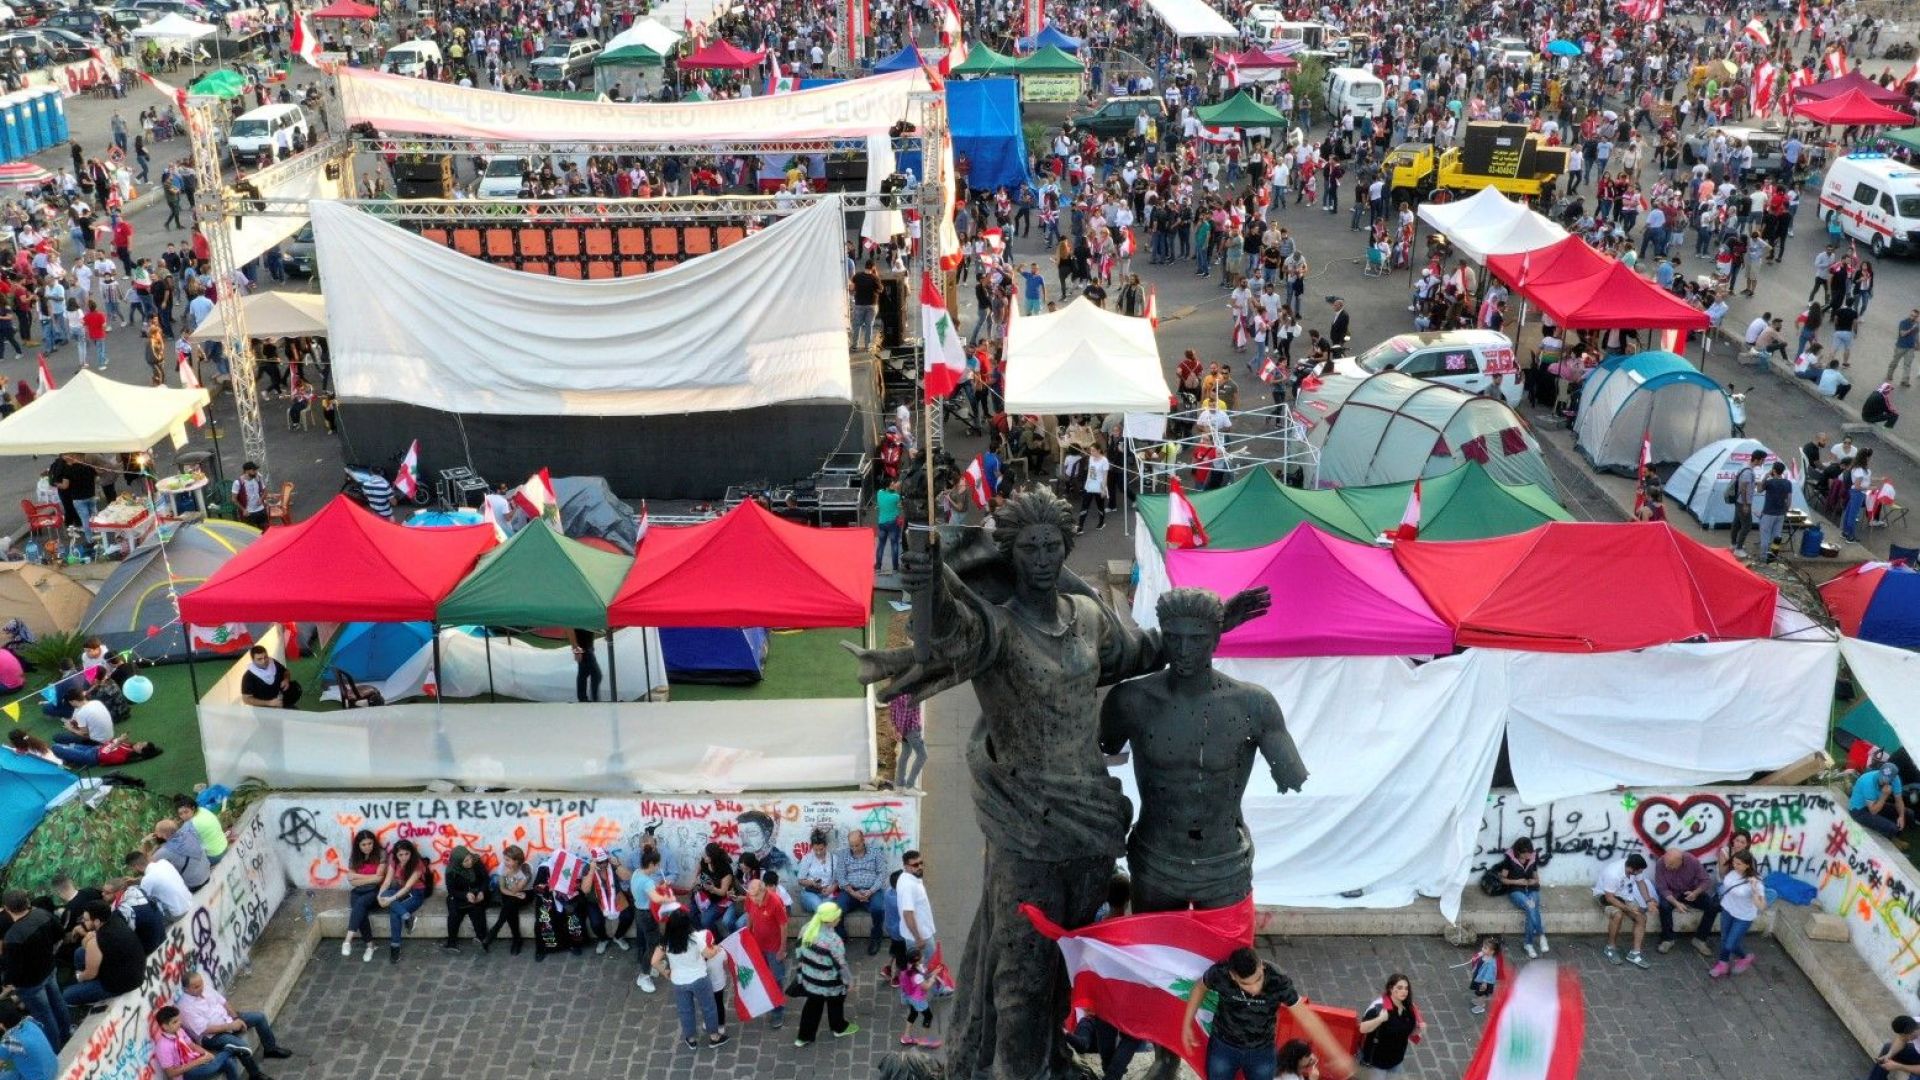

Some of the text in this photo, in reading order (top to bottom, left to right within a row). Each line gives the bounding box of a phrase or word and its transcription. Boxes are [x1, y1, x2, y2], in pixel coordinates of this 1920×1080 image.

[360, 798, 598, 819] VIVE LA REVOLUTION
[641, 799, 711, 819] NATHALY
[1733, 806, 1807, 830] ROAR
[1655, 806, 1714, 847] ثورة
